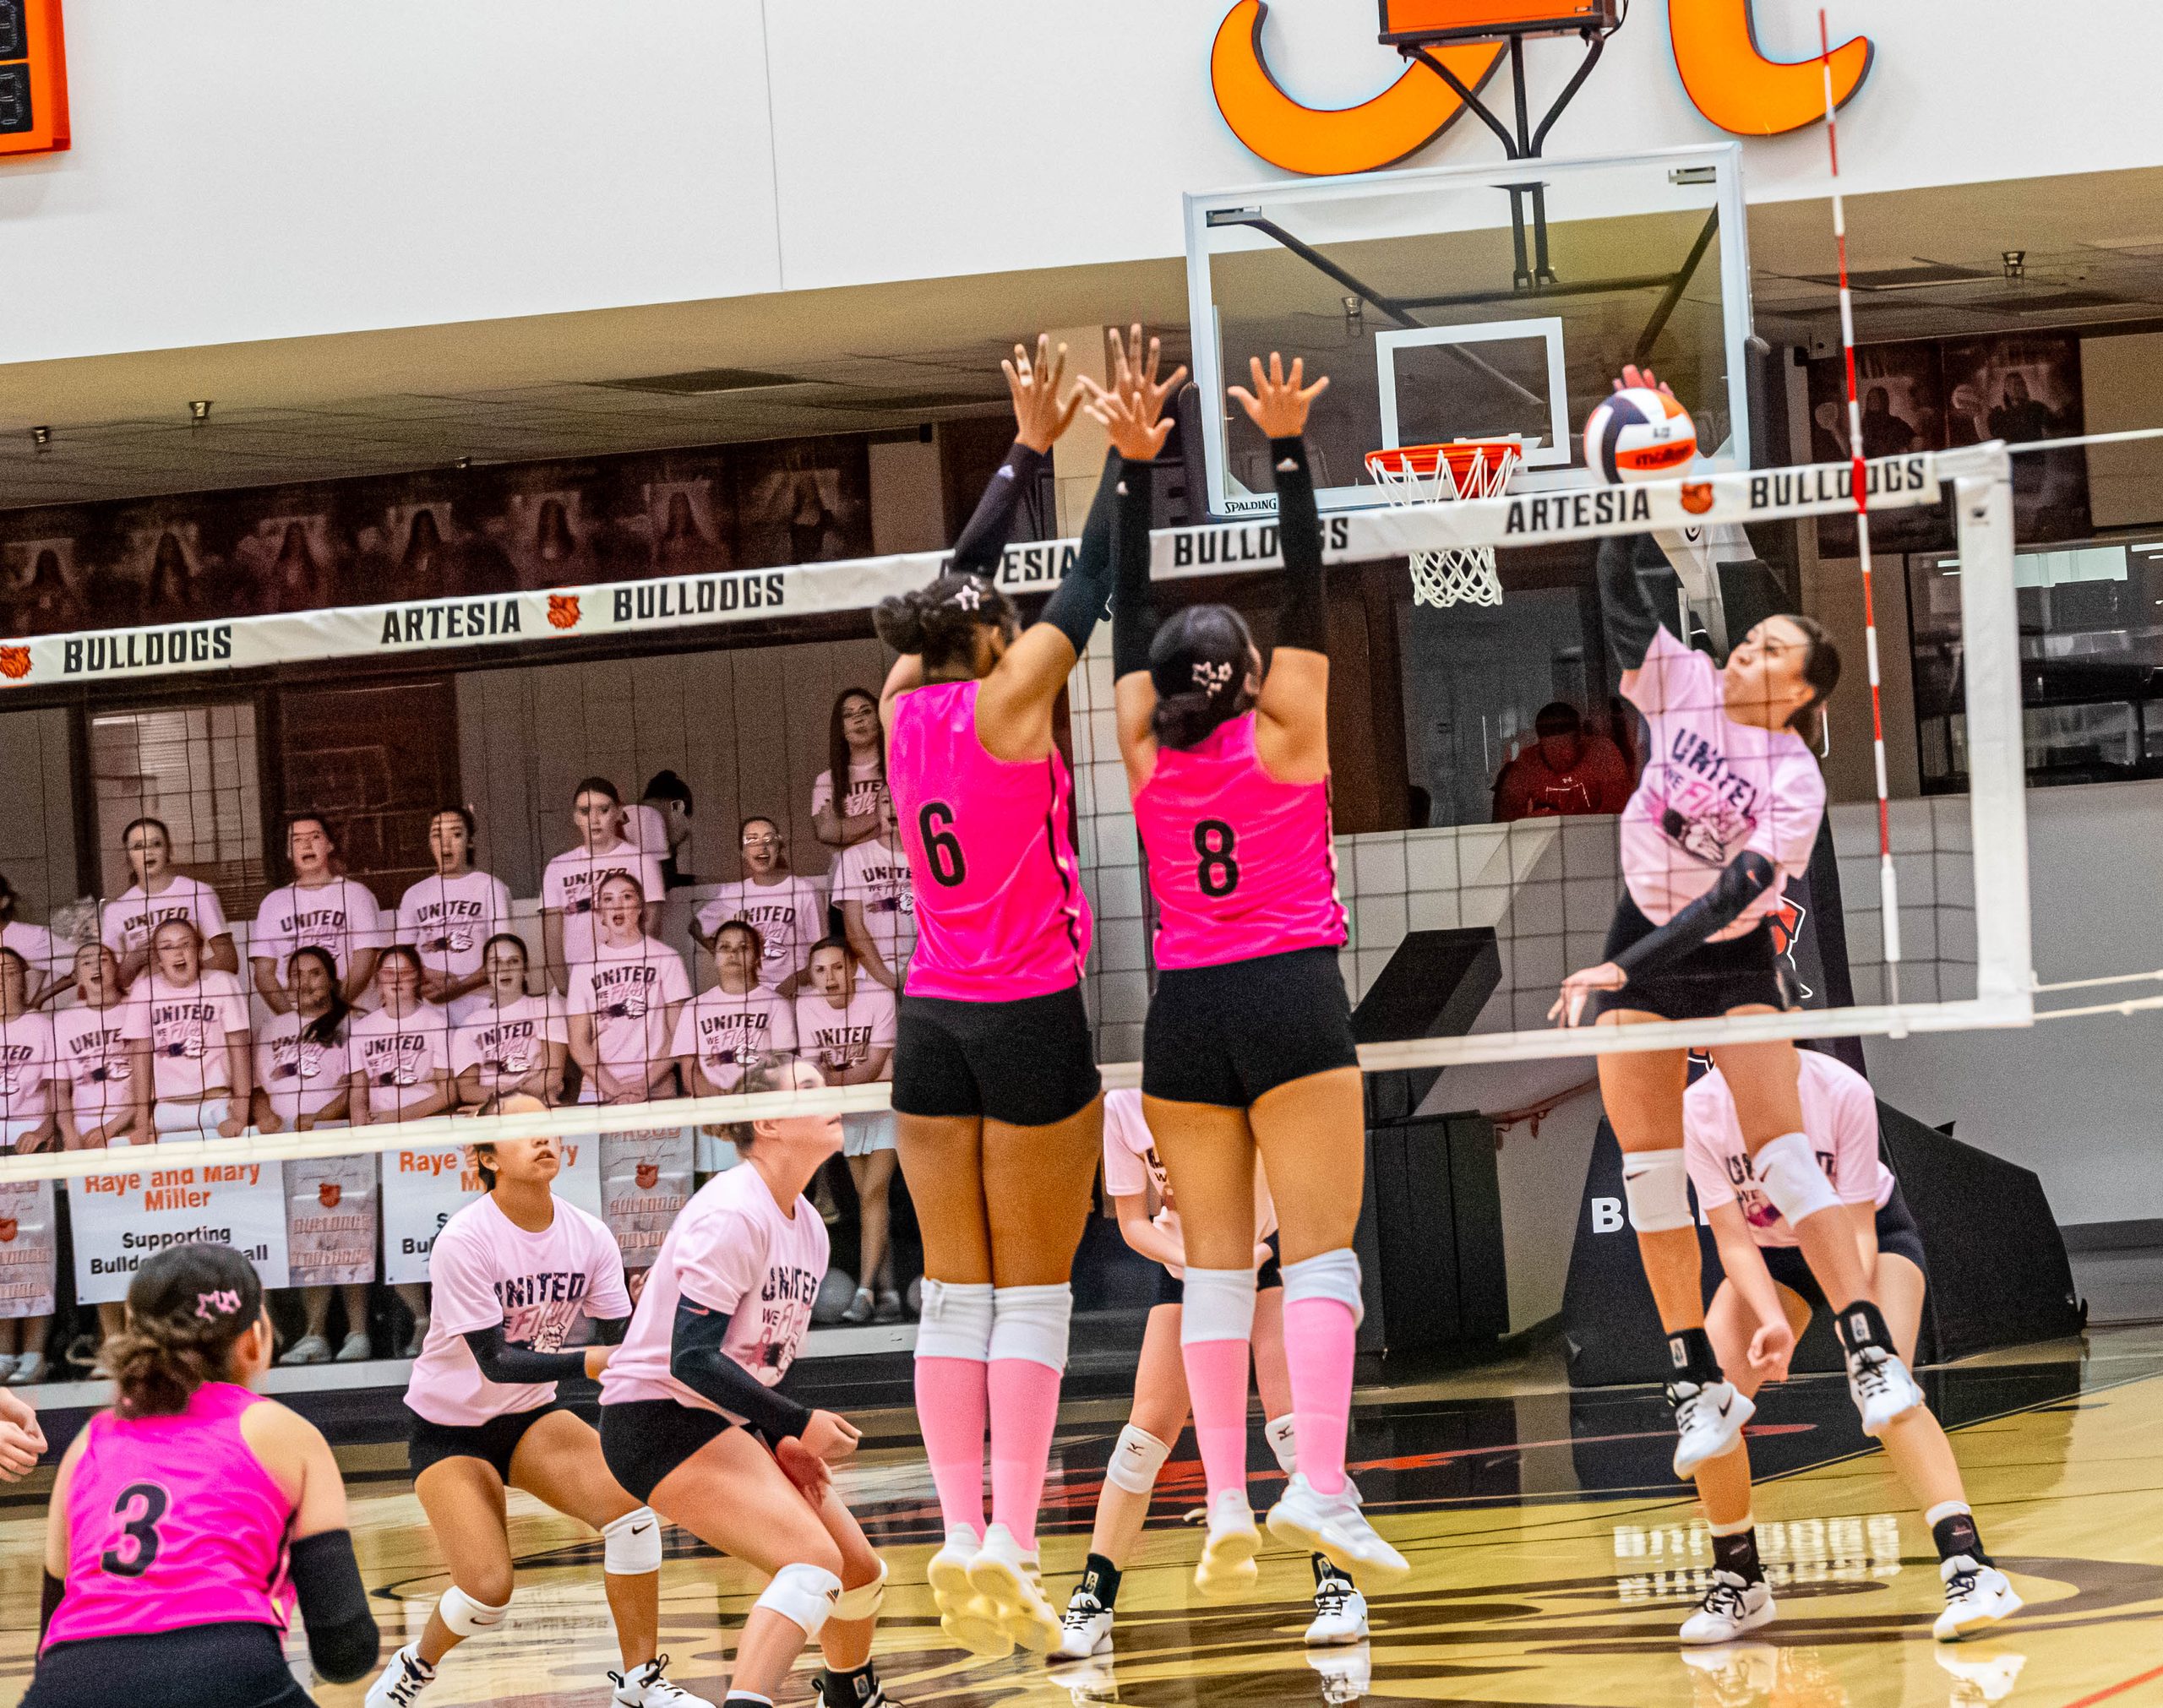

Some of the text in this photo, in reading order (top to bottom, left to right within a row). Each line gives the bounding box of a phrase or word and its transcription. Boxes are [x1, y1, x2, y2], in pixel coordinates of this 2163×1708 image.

[1224, 498, 1277, 514] SPALDING
[1506, 487, 1650, 535] ARTESIA
[1174, 517, 1348, 568] BULLDS
[1002, 545, 1080, 585] ESIA
[613, 574, 784, 623] BULLDOGS
[381, 600, 522, 645] ARTESIA
[63, 626, 232, 674] BULLDOGS
[918, 802, 965, 888] 6
[1194, 819, 1240, 898] 8
[862, 867, 911, 883] UNITE
[281, 910, 346, 933] UNITED
[417, 900, 482, 922] UNITED
[591, 966, 657, 990] UNITED
[152, 1004, 215, 1025] UNITED
[700, 1014, 768, 1035] UNITED
[0, 1045, 35, 1061] TED
[69, 1028, 123, 1055] UNITE
[365, 1035, 424, 1058] UNITED
[399, 1150, 458, 1177] Raye
[85, 1173, 142, 1196] Raye
[204, 1163, 260, 1186] Mary
[144, 1188, 212, 1212] Miller
[123, 1226, 231, 1251] Supporting
[91, 1255, 140, 1275] Bulld
[762, 1308, 780, 1326] WE
[101, 1482, 170, 1579] 3
